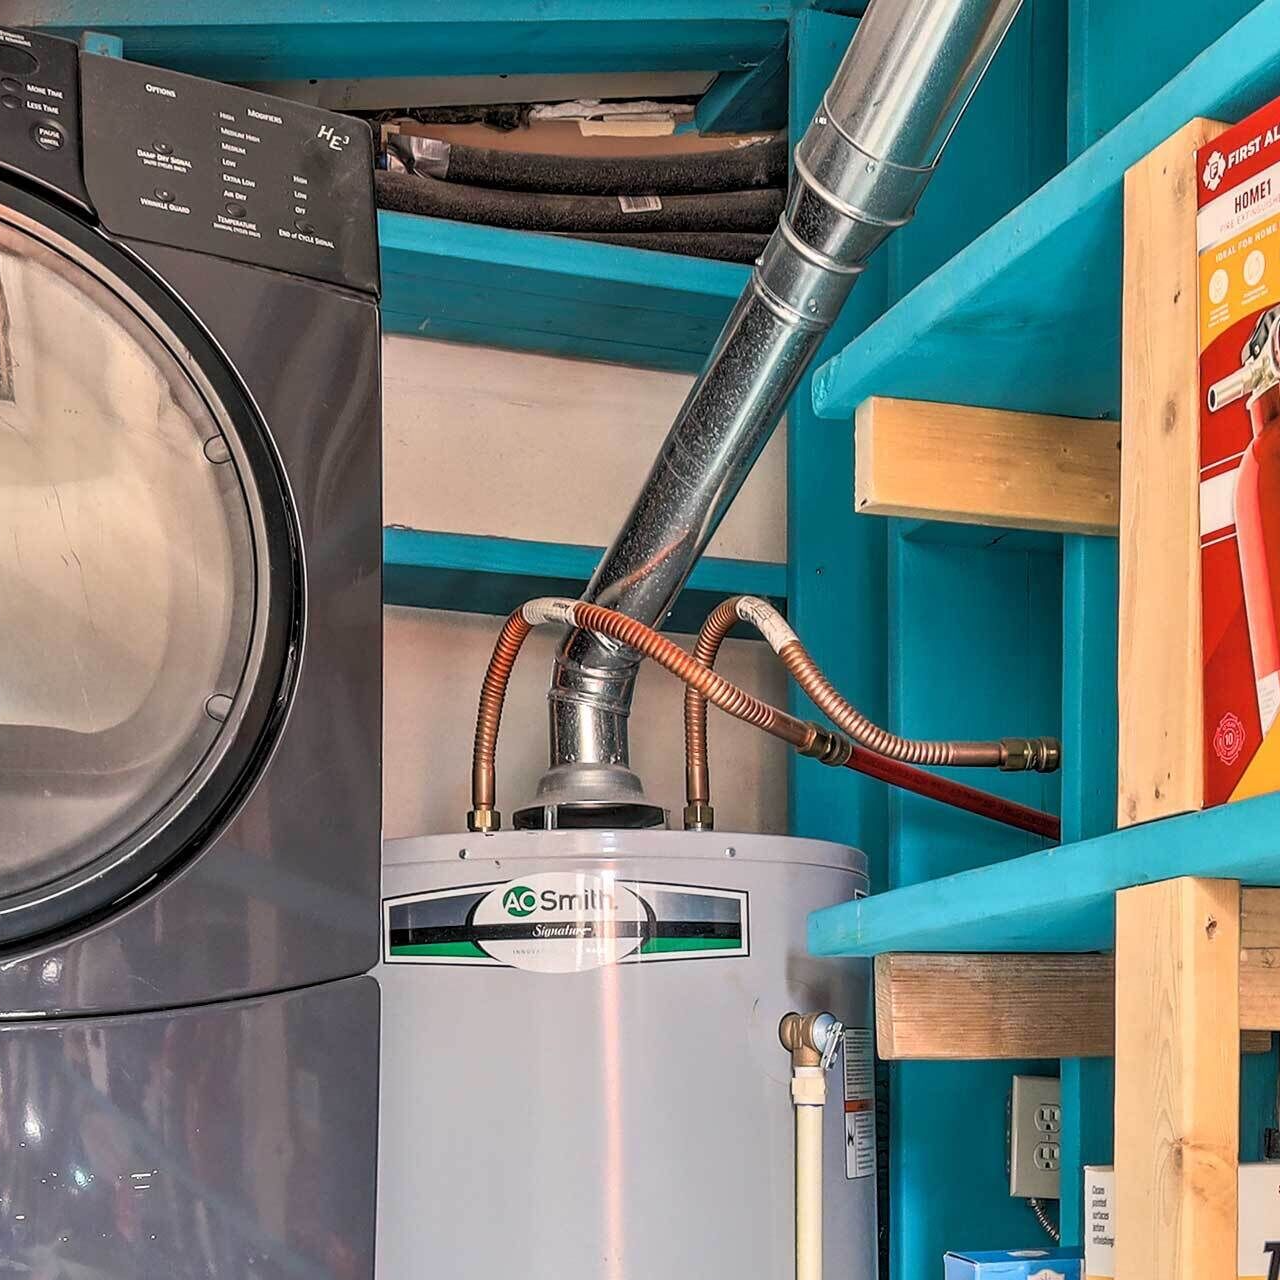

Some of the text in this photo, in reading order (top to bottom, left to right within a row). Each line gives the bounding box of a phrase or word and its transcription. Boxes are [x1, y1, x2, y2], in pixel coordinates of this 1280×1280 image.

[144, 83, 177, 98] OPTIONS
[1228, 133, 1263, 170] FIRST
[1234, 181, 1273, 213] HOME1
[540, 888, 616, 912] Smith
[532, 922, 592, 939] Signature
